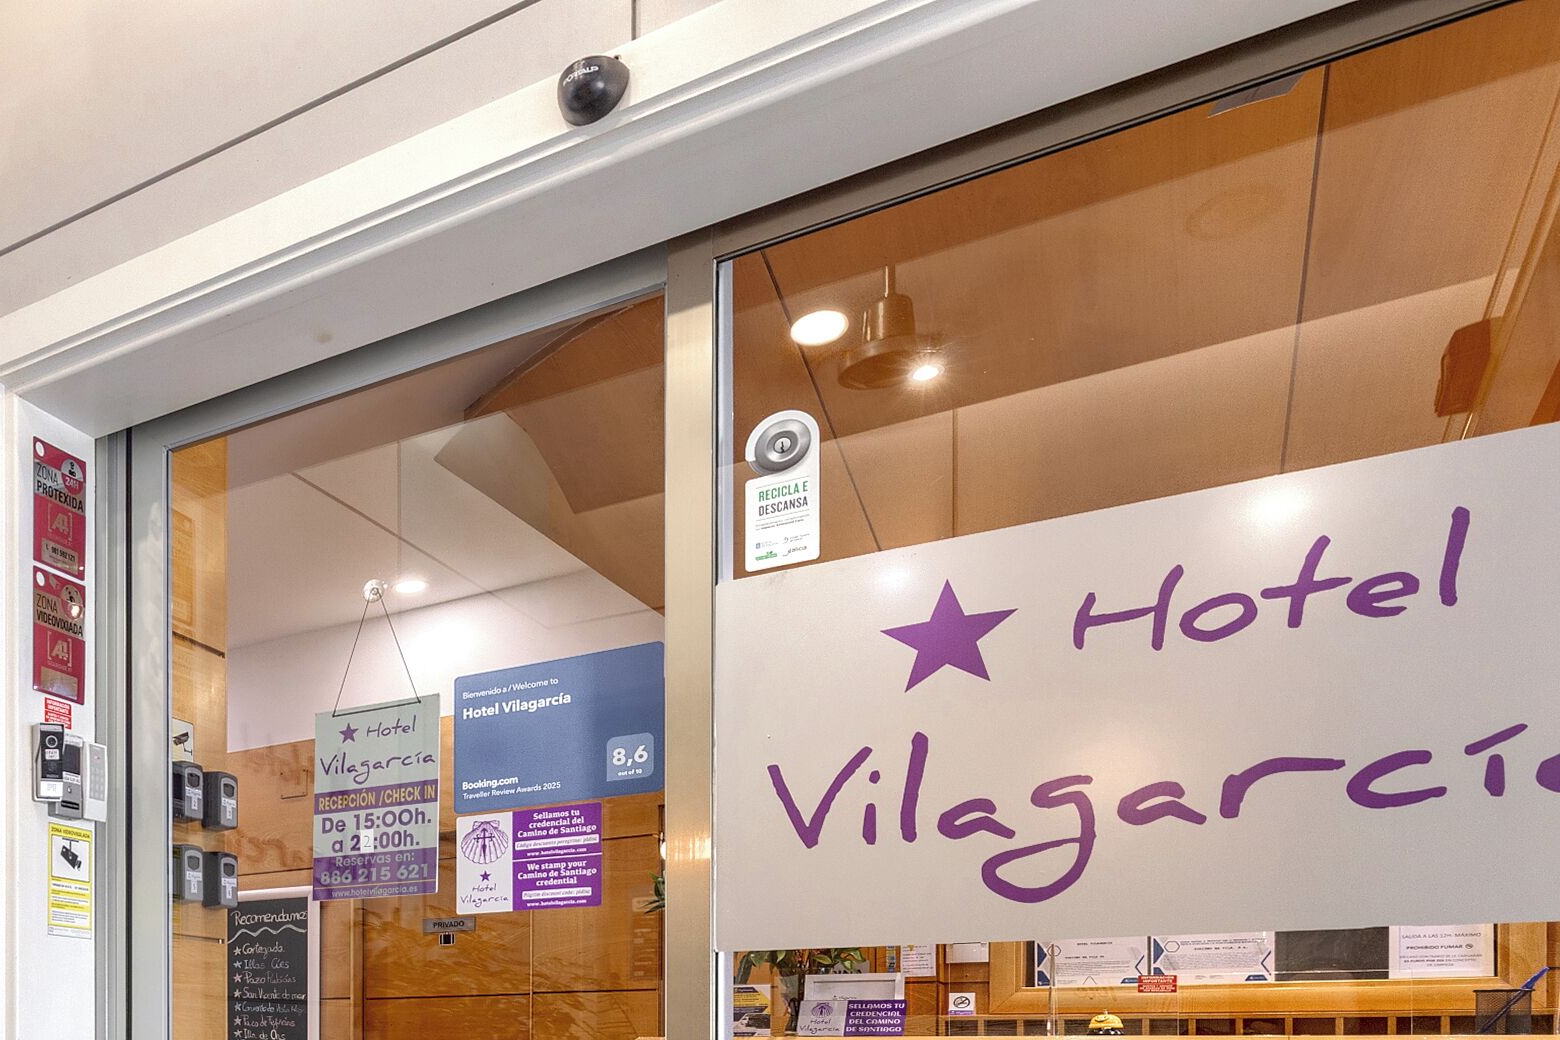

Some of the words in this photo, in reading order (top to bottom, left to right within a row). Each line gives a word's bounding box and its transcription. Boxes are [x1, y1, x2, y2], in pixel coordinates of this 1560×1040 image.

[36, 463, 58, 484] ZONA
[36, 480, 84, 513] PROTEXIDA
[758, 483, 800, 502] RECICLA
[802, 480, 809, 492] E
[758, 496, 808, 516] DESCANSA
[1072, 505, 1471, 652] Hotel
[36, 593, 58, 613] ZONA
[462, 686, 502, 700] Bienvenido
[512, 679, 549, 692] Welcome
[463, 702, 499, 719] Hotel
[502, 692, 571, 713] Vilagarcía
[366, 715, 417, 738] Hotel
[612, 744, 648, 767] 8,6
[320, 751, 436, 785] Vilagarcía
[462, 776, 518, 791] Booking.com
[463, 790, 490, 800] Traveller
[491, 788, 515, 797] Review
[516, 785, 542, 793] Awards
[543, 781, 561, 790] 2025
[318, 788, 376, 812] RECEPCIÓN
[424, 784, 435, 799] IN
[529, 818, 570, 829] credencial
[572, 816, 584, 824] del
[533, 810, 569, 820] Sellamos
[321, 818, 346, 834] De
[517, 827, 548, 838] Camino
[549, 827, 559, 835] de
[560, 824, 597, 836] Santiago
[332, 840, 344, 853] a
[350, 830, 420, 851] 22:00h.
[335, 852, 391, 867] Reservas
[395, 850, 415, 862] en:
[527, 863, 539, 871] We
[541, 861, 565, 871] stamp
[568, 860, 587, 869] your
[320, 870, 352, 886] 886
[358, 867, 391, 882] 215
[397, 864, 429, 879] 621
[518, 869, 547, 880] Camino
[549, 869, 559, 877] de
[560, 867, 597, 878] Santiago
[536, 876, 577, 886] credential
[472, 883, 497, 893] Hotel
[433, 920, 465, 928] PRIVADO
